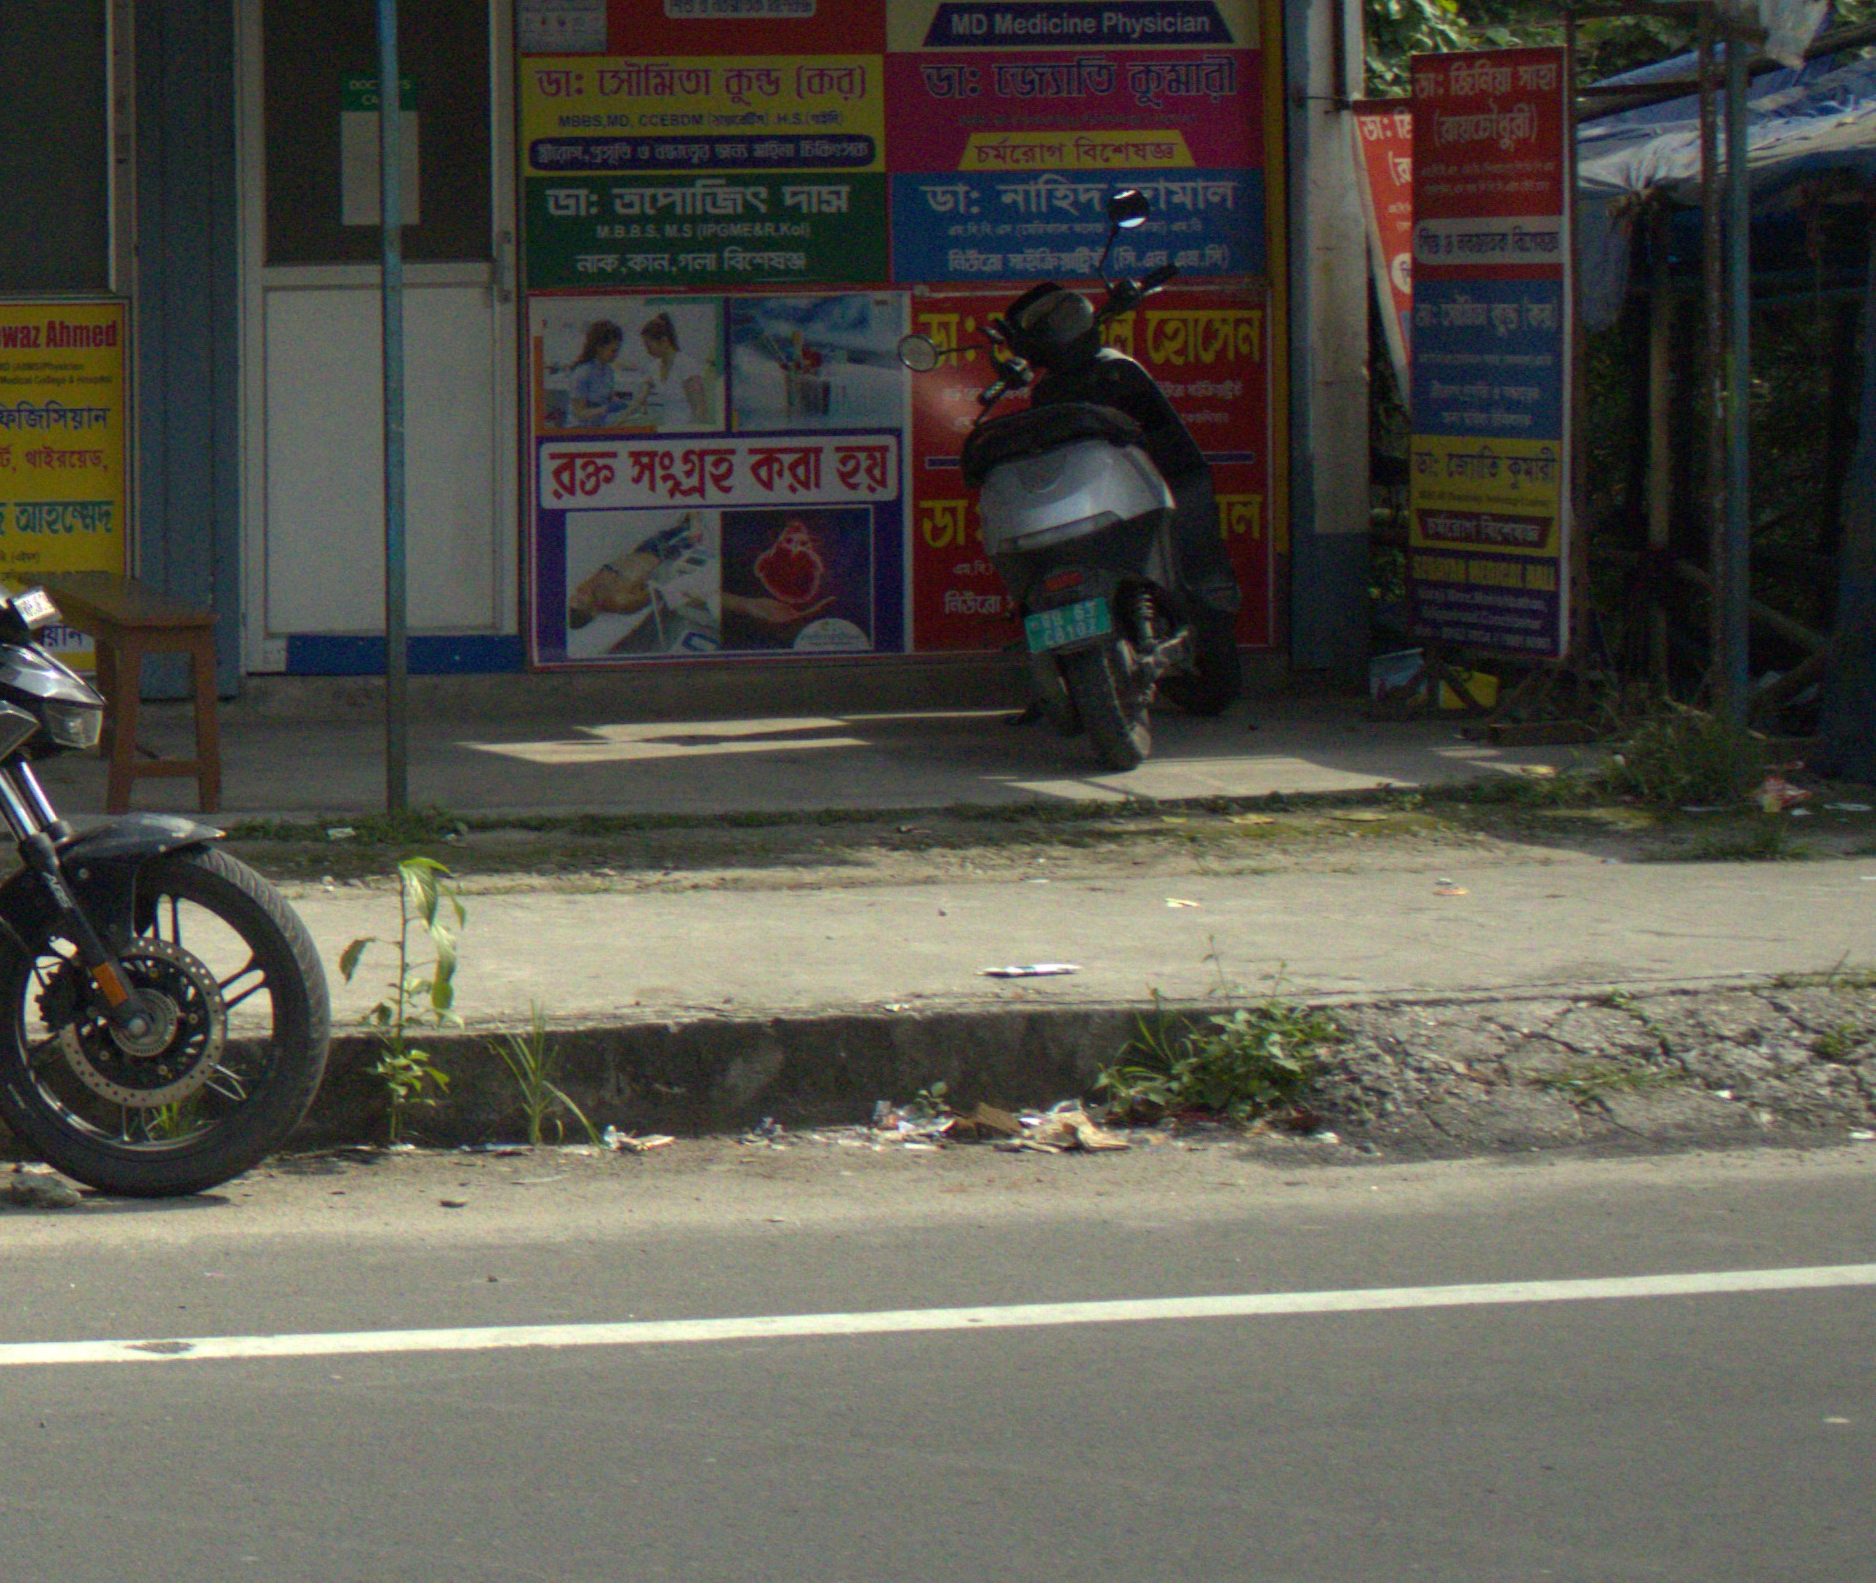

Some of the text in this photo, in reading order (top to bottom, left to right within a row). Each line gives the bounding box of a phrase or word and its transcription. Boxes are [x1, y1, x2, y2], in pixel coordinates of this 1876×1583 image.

[951, 12, 1211, 39] MD Medicine Physician
[45, 319, 117, 348] Ahmed
[548, 444, 890, 501] রক্ত সংগ্রহ করা হয়
